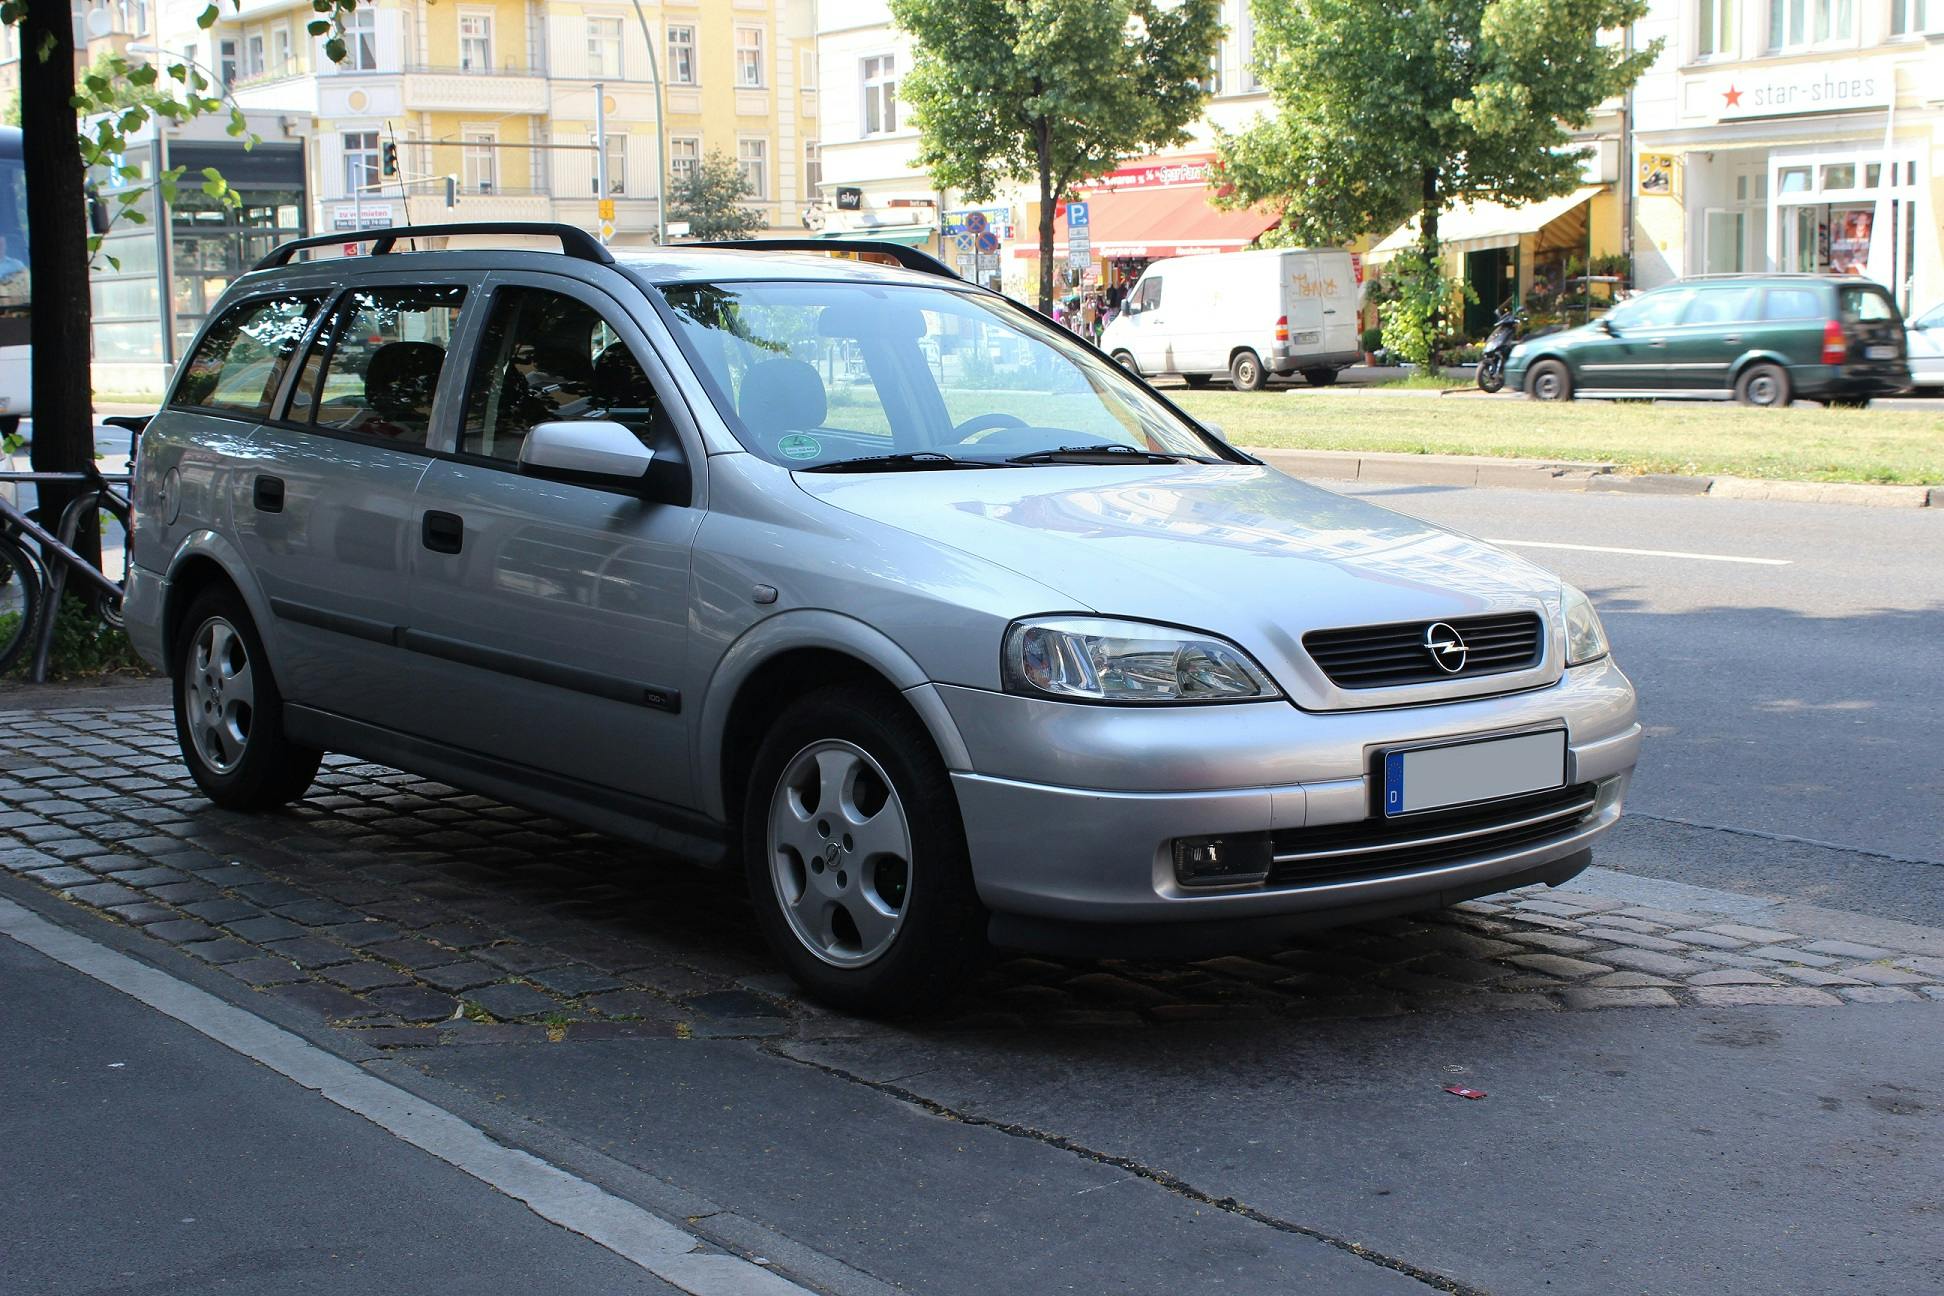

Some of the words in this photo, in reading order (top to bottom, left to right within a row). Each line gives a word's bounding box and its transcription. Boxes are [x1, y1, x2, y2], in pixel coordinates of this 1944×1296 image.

[1754, 73, 1875, 106] star-shoes
[841, 192, 859, 206] sky
[1070, 204, 1084, 225] P
[1390, 790, 1398, 804] D
